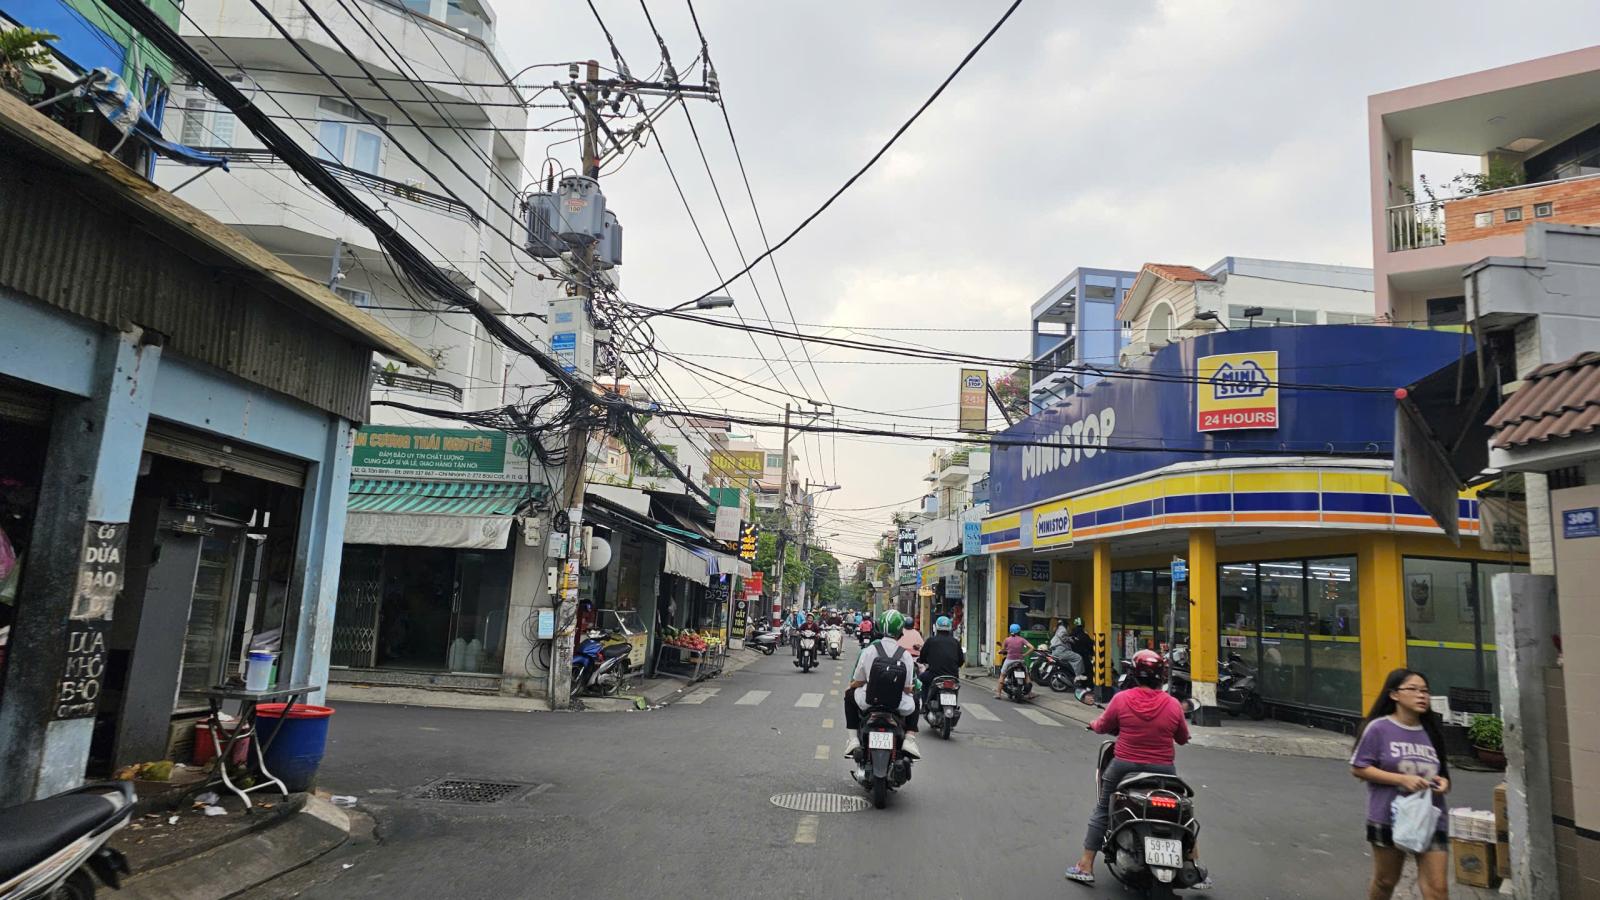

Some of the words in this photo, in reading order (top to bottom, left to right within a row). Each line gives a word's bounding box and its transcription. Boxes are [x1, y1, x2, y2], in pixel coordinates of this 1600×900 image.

[1222, 371, 1256, 382] MINI
[1220, 382, 1258, 395] STOP
[1204, 415, 1219, 426] 24
[1223, 412, 1276, 424] HOURS
[414, 433, 440, 450] THÁI
[1021, 407, 1116, 481] MINISTOP
[711, 454, 734, 470] BÚN
[739, 453, 762, 470] CHẢ
[1038, 516, 1068, 533] MINISTOP
[85, 542, 120, 563] DỪA
[64, 653, 105, 678] KHÔ
[1150, 840, 1176, 853] 59-P2
